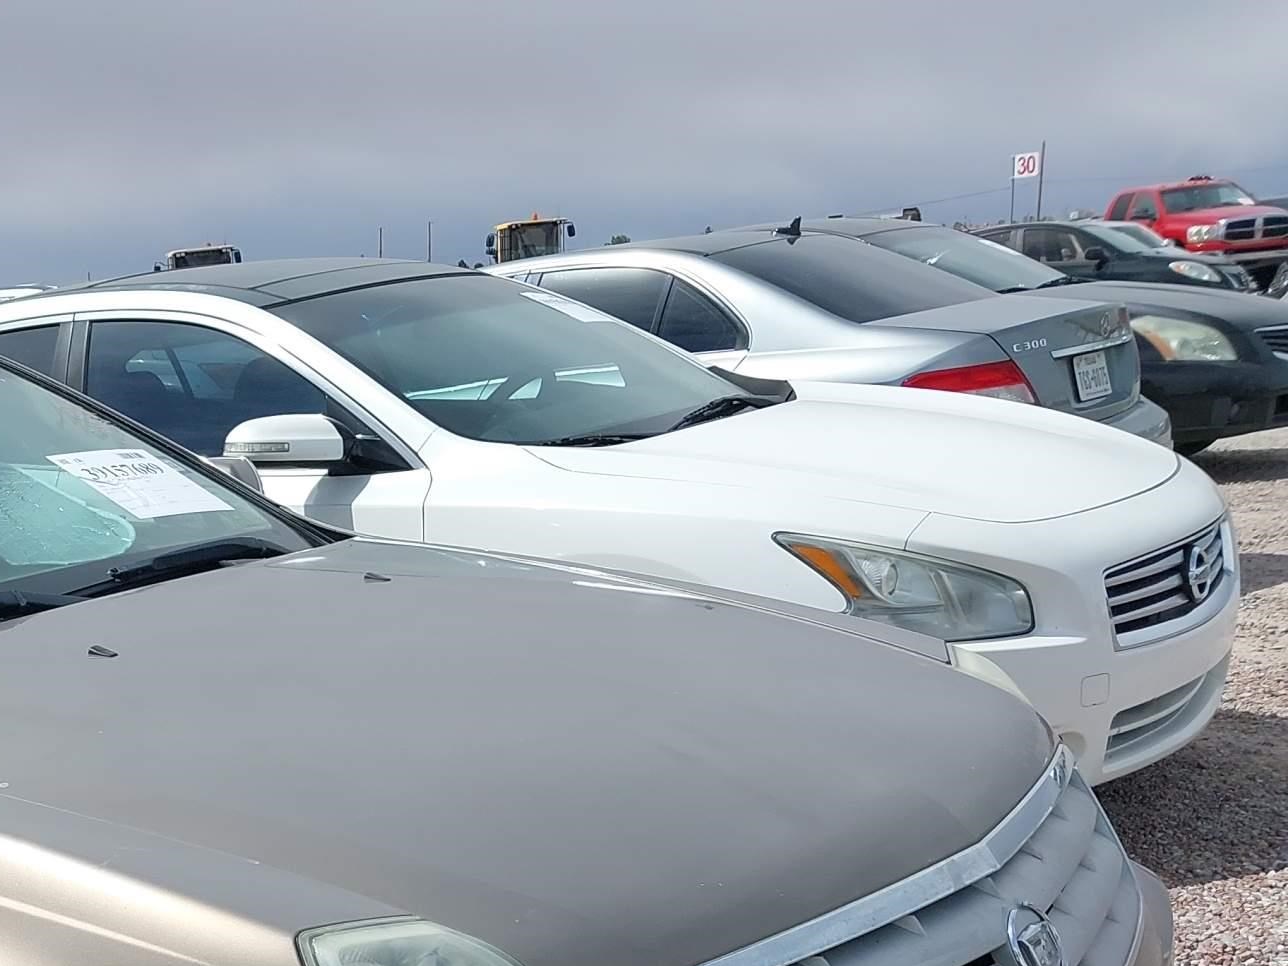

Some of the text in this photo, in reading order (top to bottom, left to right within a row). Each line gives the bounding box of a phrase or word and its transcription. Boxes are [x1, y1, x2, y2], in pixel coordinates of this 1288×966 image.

[1016, 155, 1036, 175] 30
[1012, 338, 1048, 353] C 300
[80, 462, 165, 482] 39157689
